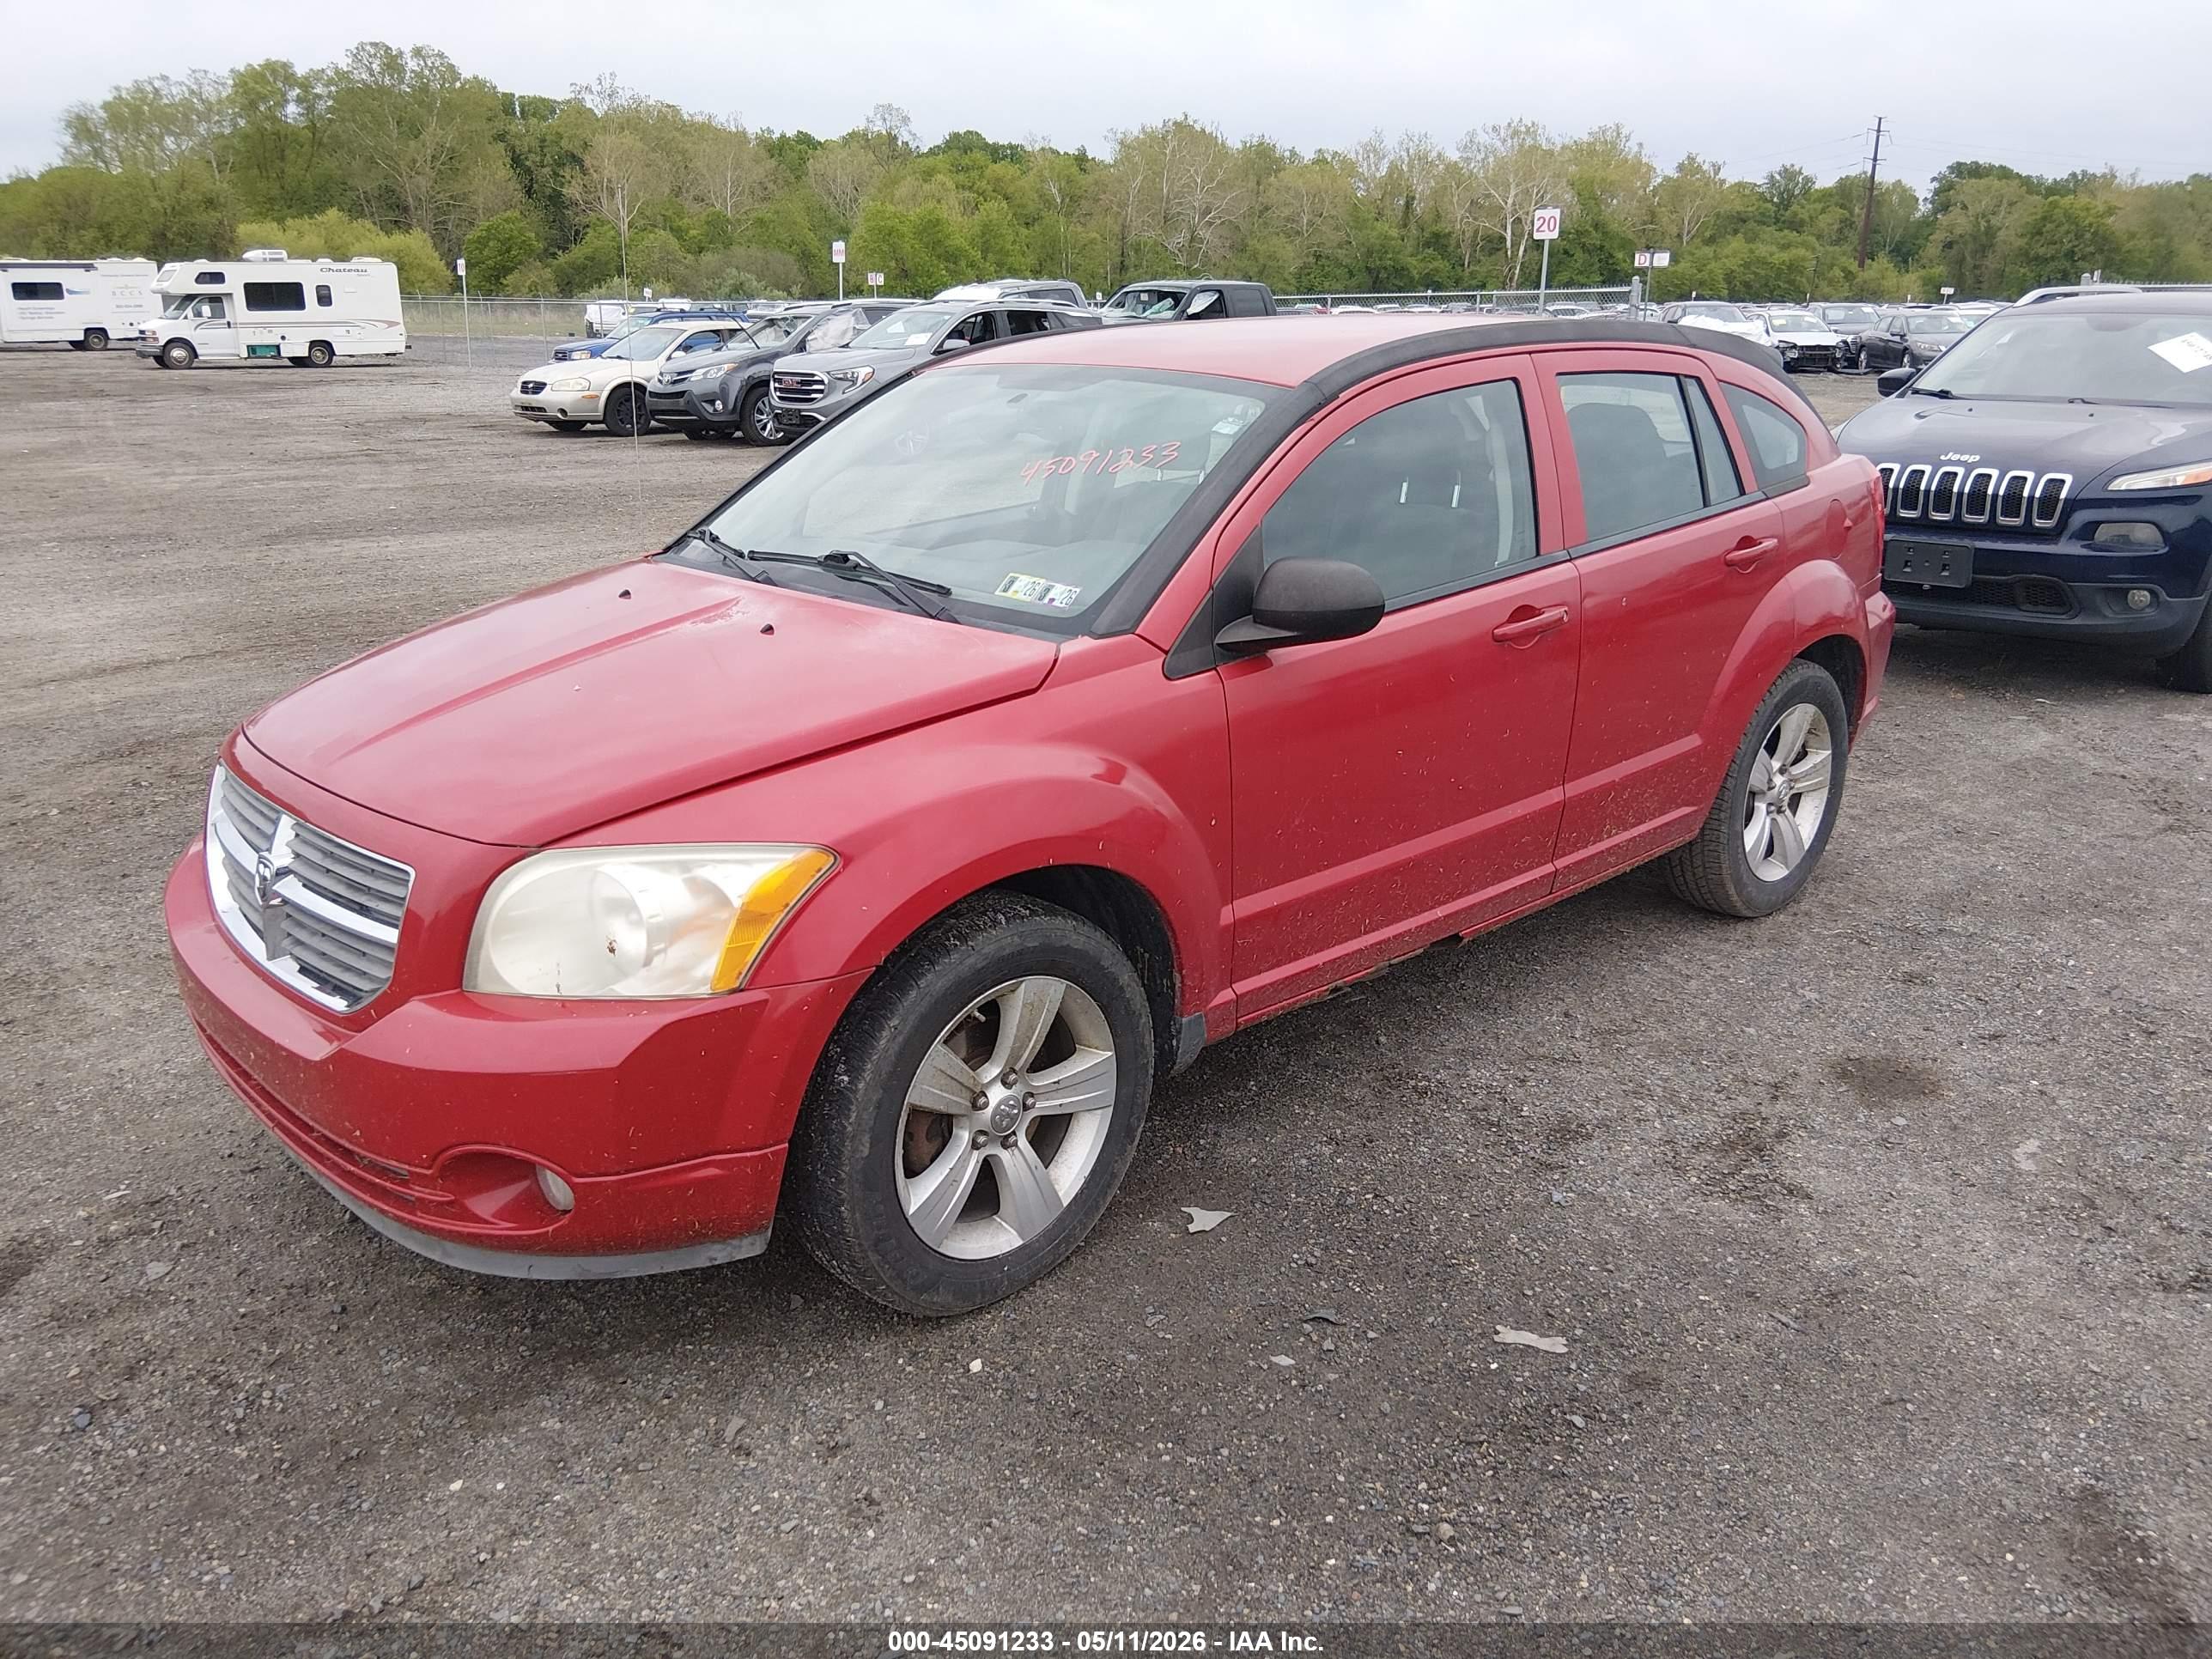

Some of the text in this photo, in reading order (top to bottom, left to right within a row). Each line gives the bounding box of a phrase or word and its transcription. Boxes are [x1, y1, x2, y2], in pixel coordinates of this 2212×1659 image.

[1535, 216, 1558, 233] 20
[834, 248, 844, 257] MM
[1638, 254, 1647, 265] D
[878, 274, 883, 283] C
[1939, 452, 1981, 464] Jeep
[1020, 441, 1182, 487] 45091233
